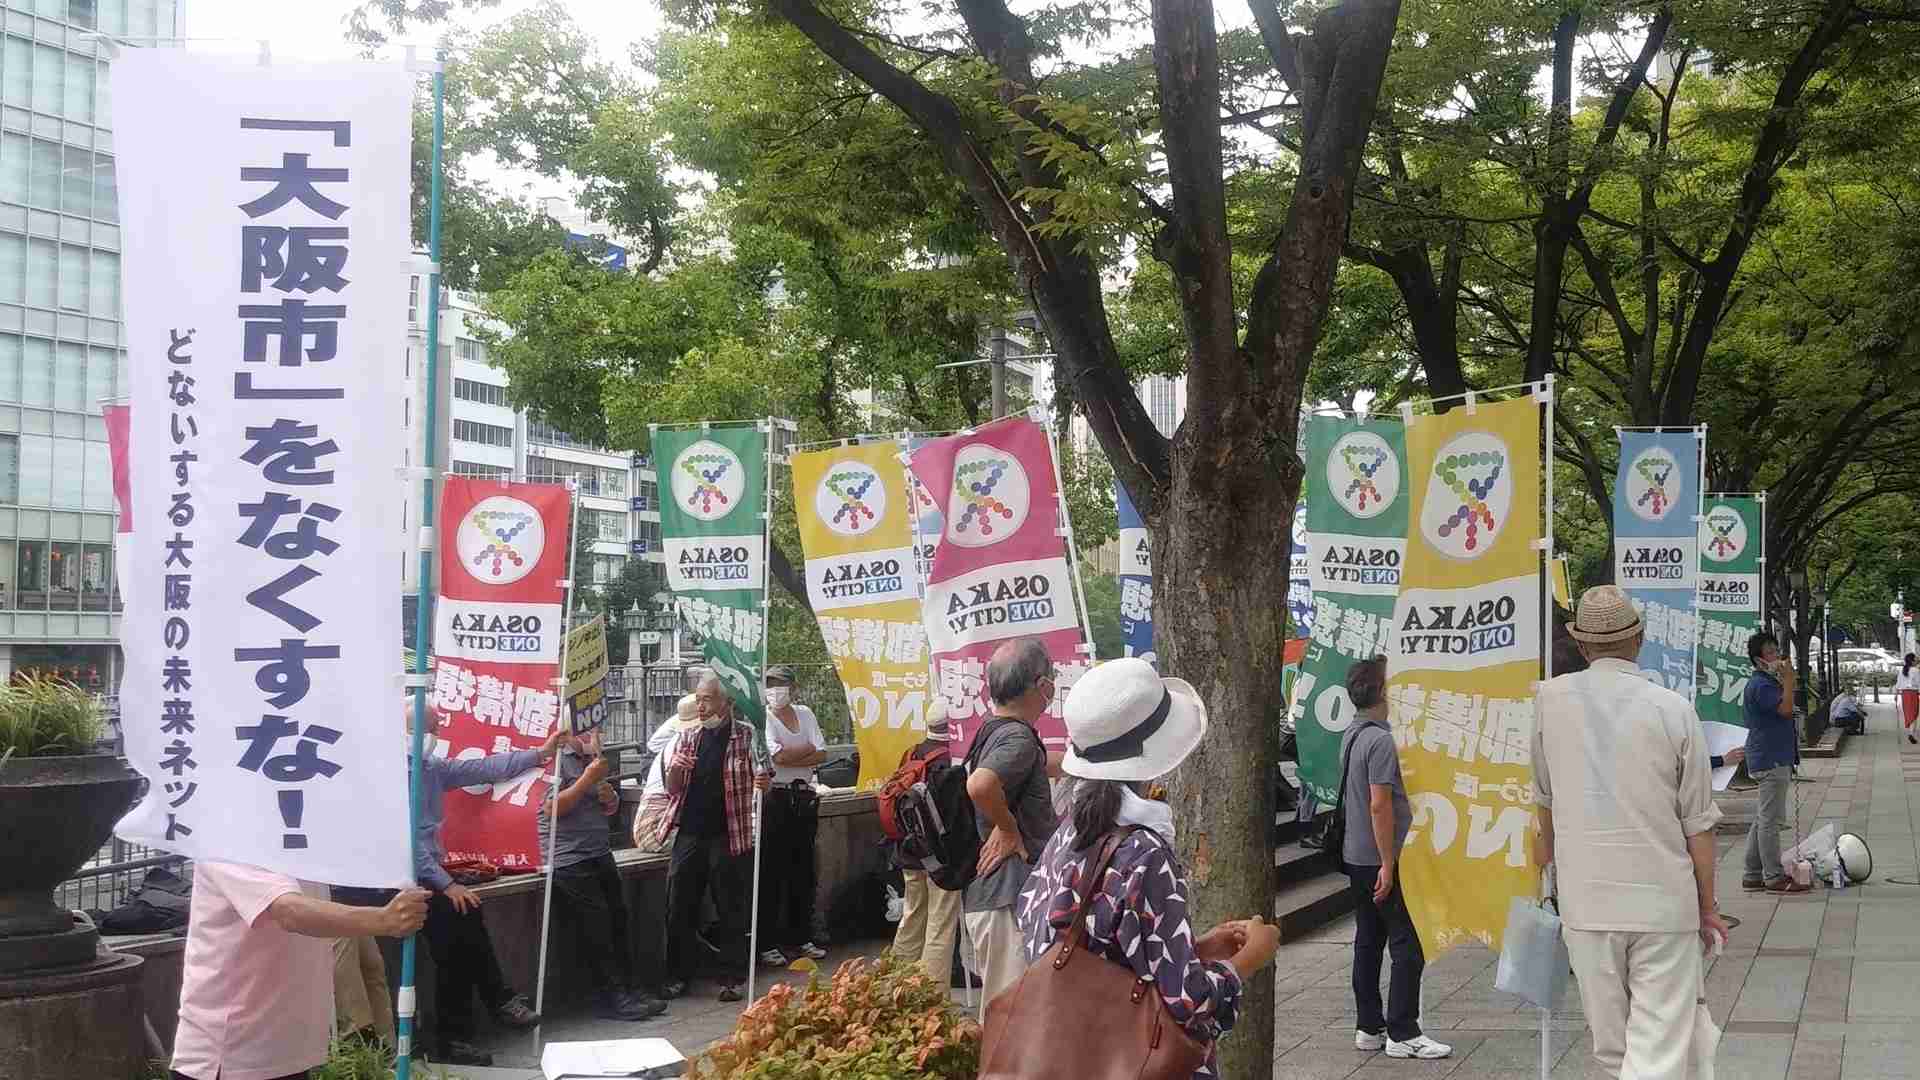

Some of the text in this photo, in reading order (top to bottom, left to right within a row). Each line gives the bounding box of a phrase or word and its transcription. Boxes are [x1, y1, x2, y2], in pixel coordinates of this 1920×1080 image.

[158, 327, 199, 842] どないする大阪の未来ネット
[234, 117, 351, 850] 「大阪市」をなくすな!
